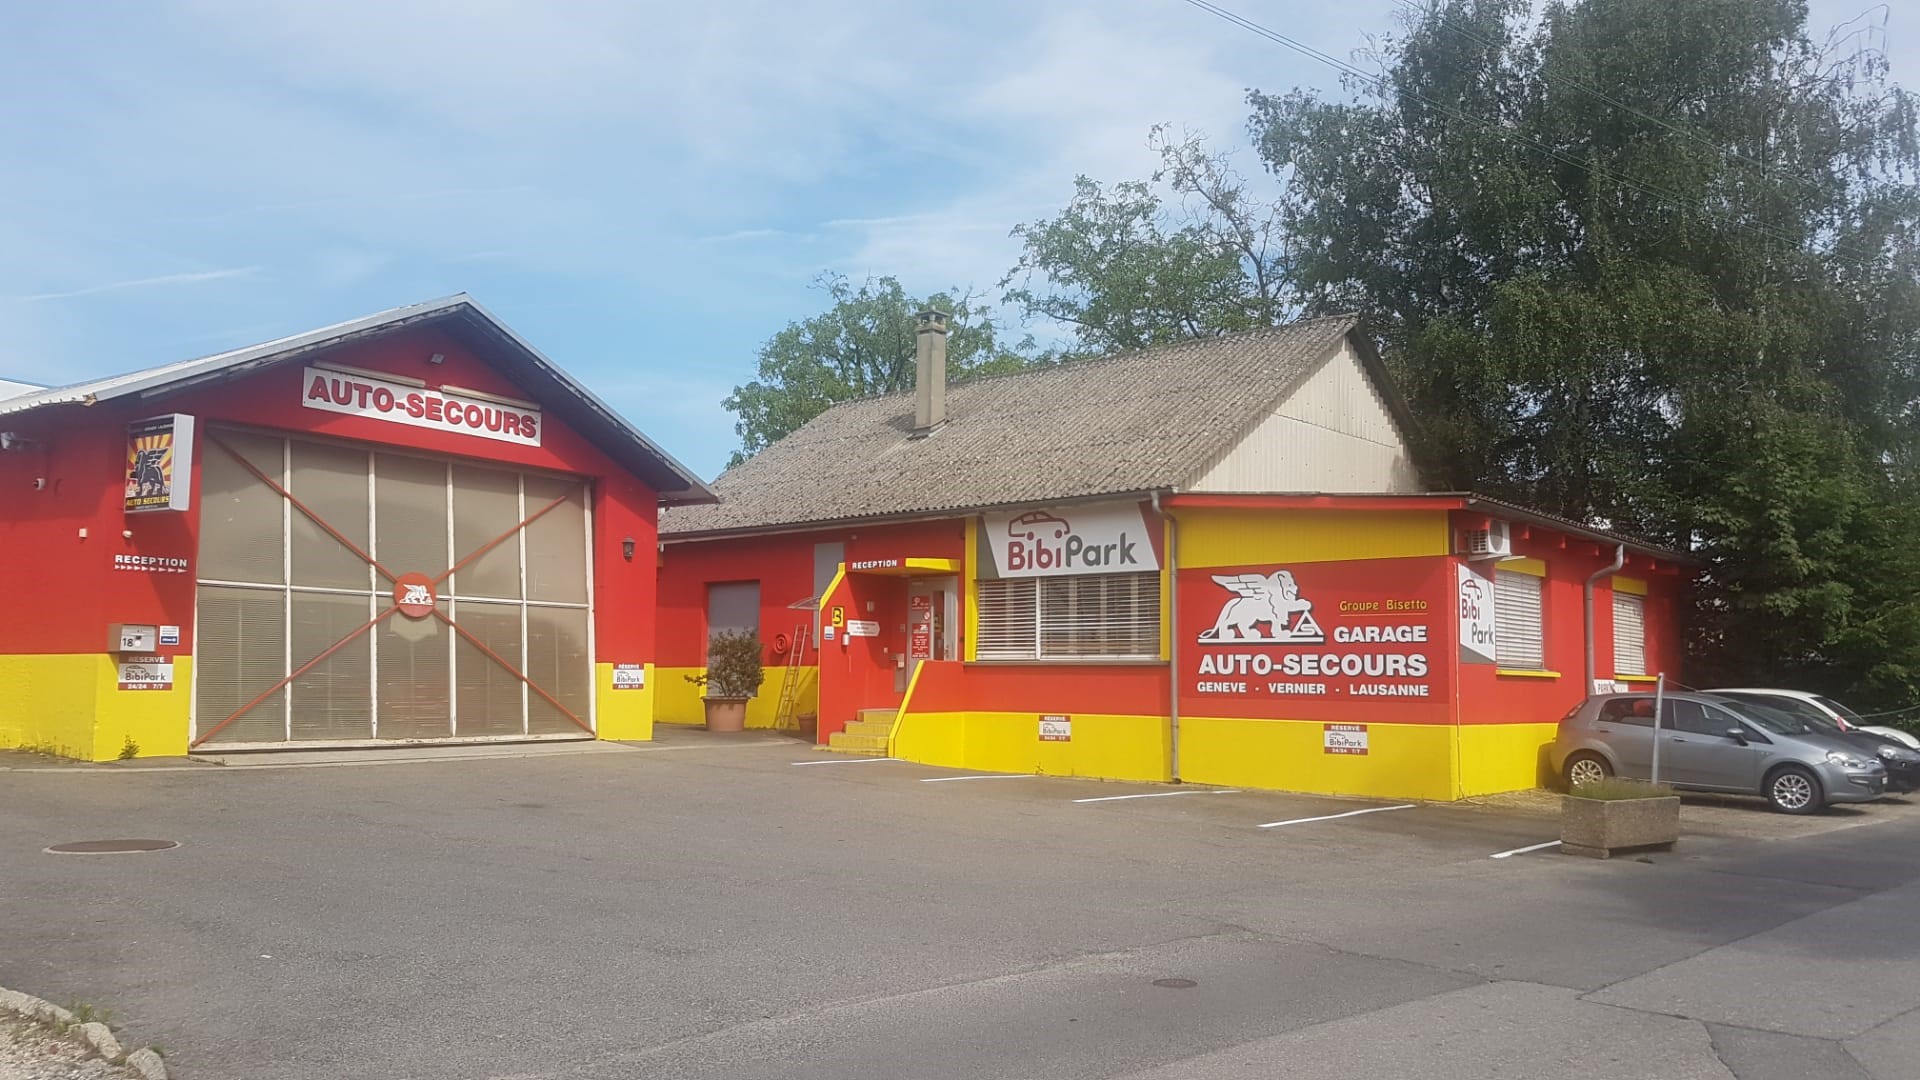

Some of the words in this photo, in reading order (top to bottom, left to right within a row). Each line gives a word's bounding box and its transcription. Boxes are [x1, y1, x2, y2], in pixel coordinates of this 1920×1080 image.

[308, 375, 537, 438] AUTO-SECOURS
[1008, 532, 1138, 571] BibiPark
[114, 554, 188, 567] RECEPTION
[852, 560, 898, 569] RECEPTION
[1339, 600, 1379, 612] Groupe
[1386, 599, 1428, 611] Bisetto
[1333, 625, 1428, 643] GARAGE
[1471, 622, 1494, 645] Park
[122, 637, 134, 648] 18
[1198, 653, 1429, 677] AUTO-SECOURS
[1197, 680, 1247, 692] GENEVE
[1268, 682, 1326, 694] VERNIER
[1349, 683, 1429, 696] LAUSANNE
